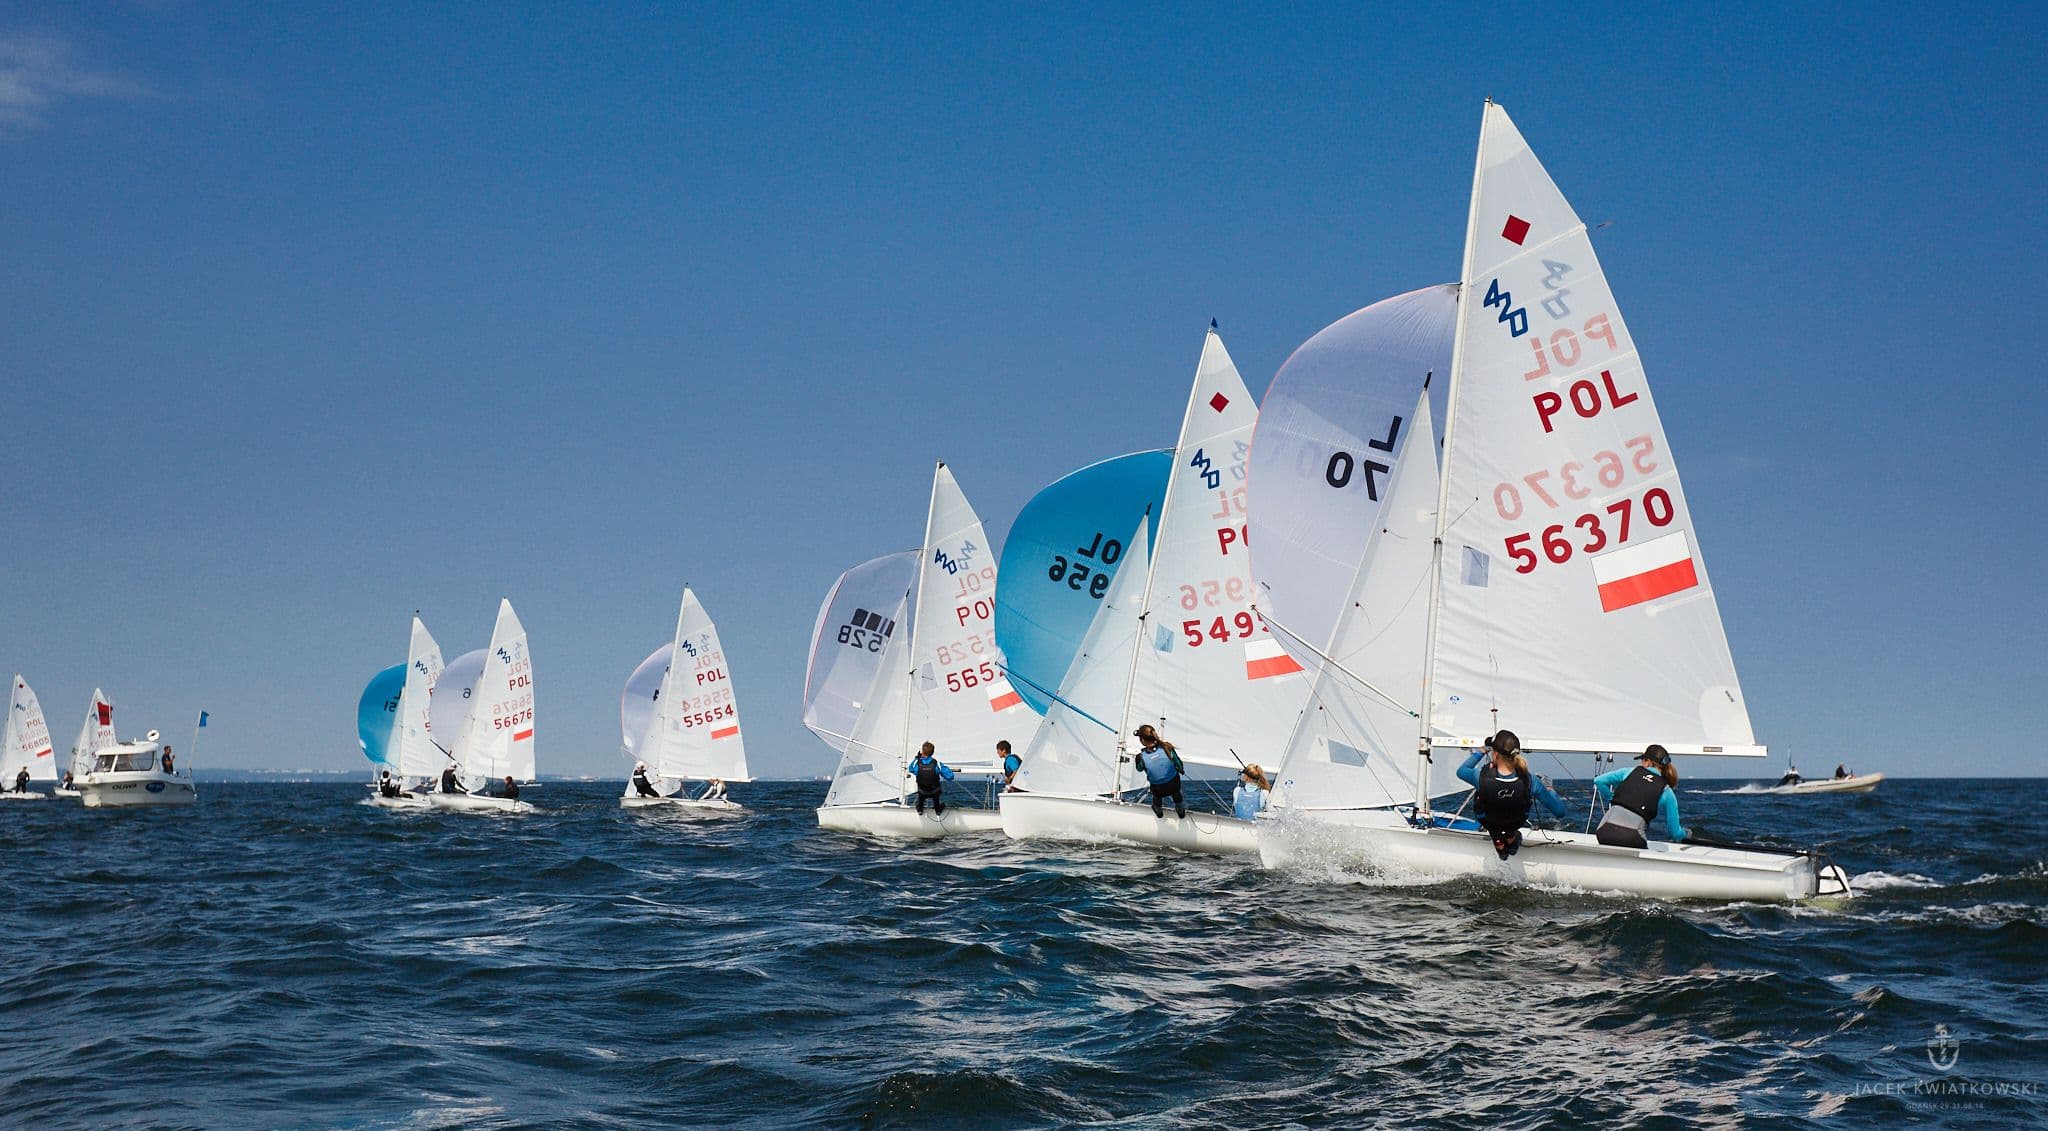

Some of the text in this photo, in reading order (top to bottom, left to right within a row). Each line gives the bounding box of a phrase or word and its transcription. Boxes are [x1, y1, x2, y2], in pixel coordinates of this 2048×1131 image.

[1483, 278, 1529, 338] 420
[1532, 369, 1639, 433] POL
[1190, 448, 1220, 489] 420
[1504, 487, 1675, 574] 56370
[934, 548, 958, 575] 420
[682, 640, 697, 657] 420
[509, 674, 531, 691] POL
[696, 668, 726, 686] POL
[494, 708, 532, 730] 56676
[683, 704, 734, 728] 55654
